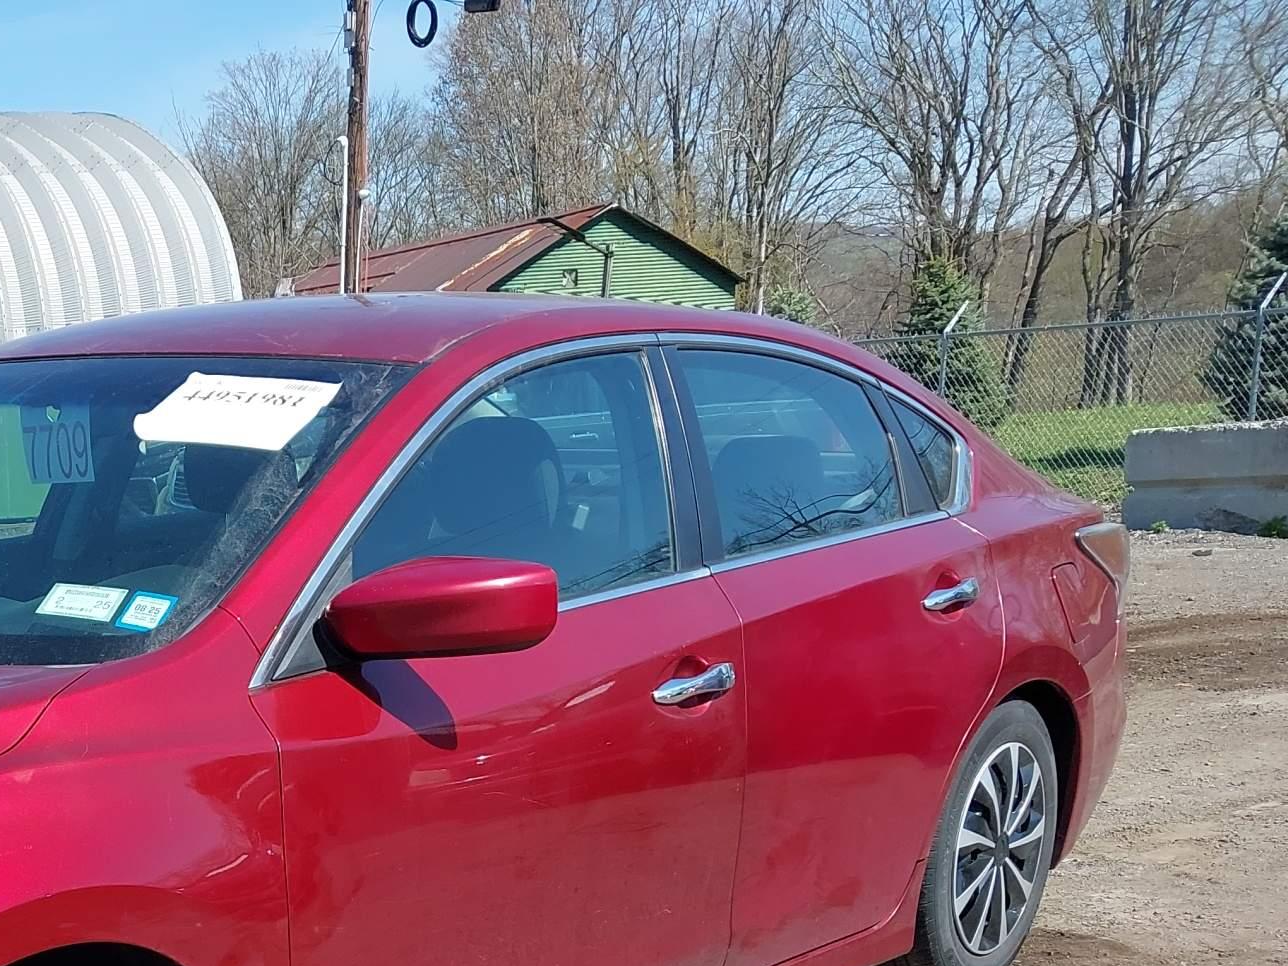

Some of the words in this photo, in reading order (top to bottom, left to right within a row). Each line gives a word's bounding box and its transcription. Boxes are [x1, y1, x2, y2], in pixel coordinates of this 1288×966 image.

[23, 421, 89, 479] 7709
[93, 600, 113, 610] 25
[148, 606, 162, 615] 25
